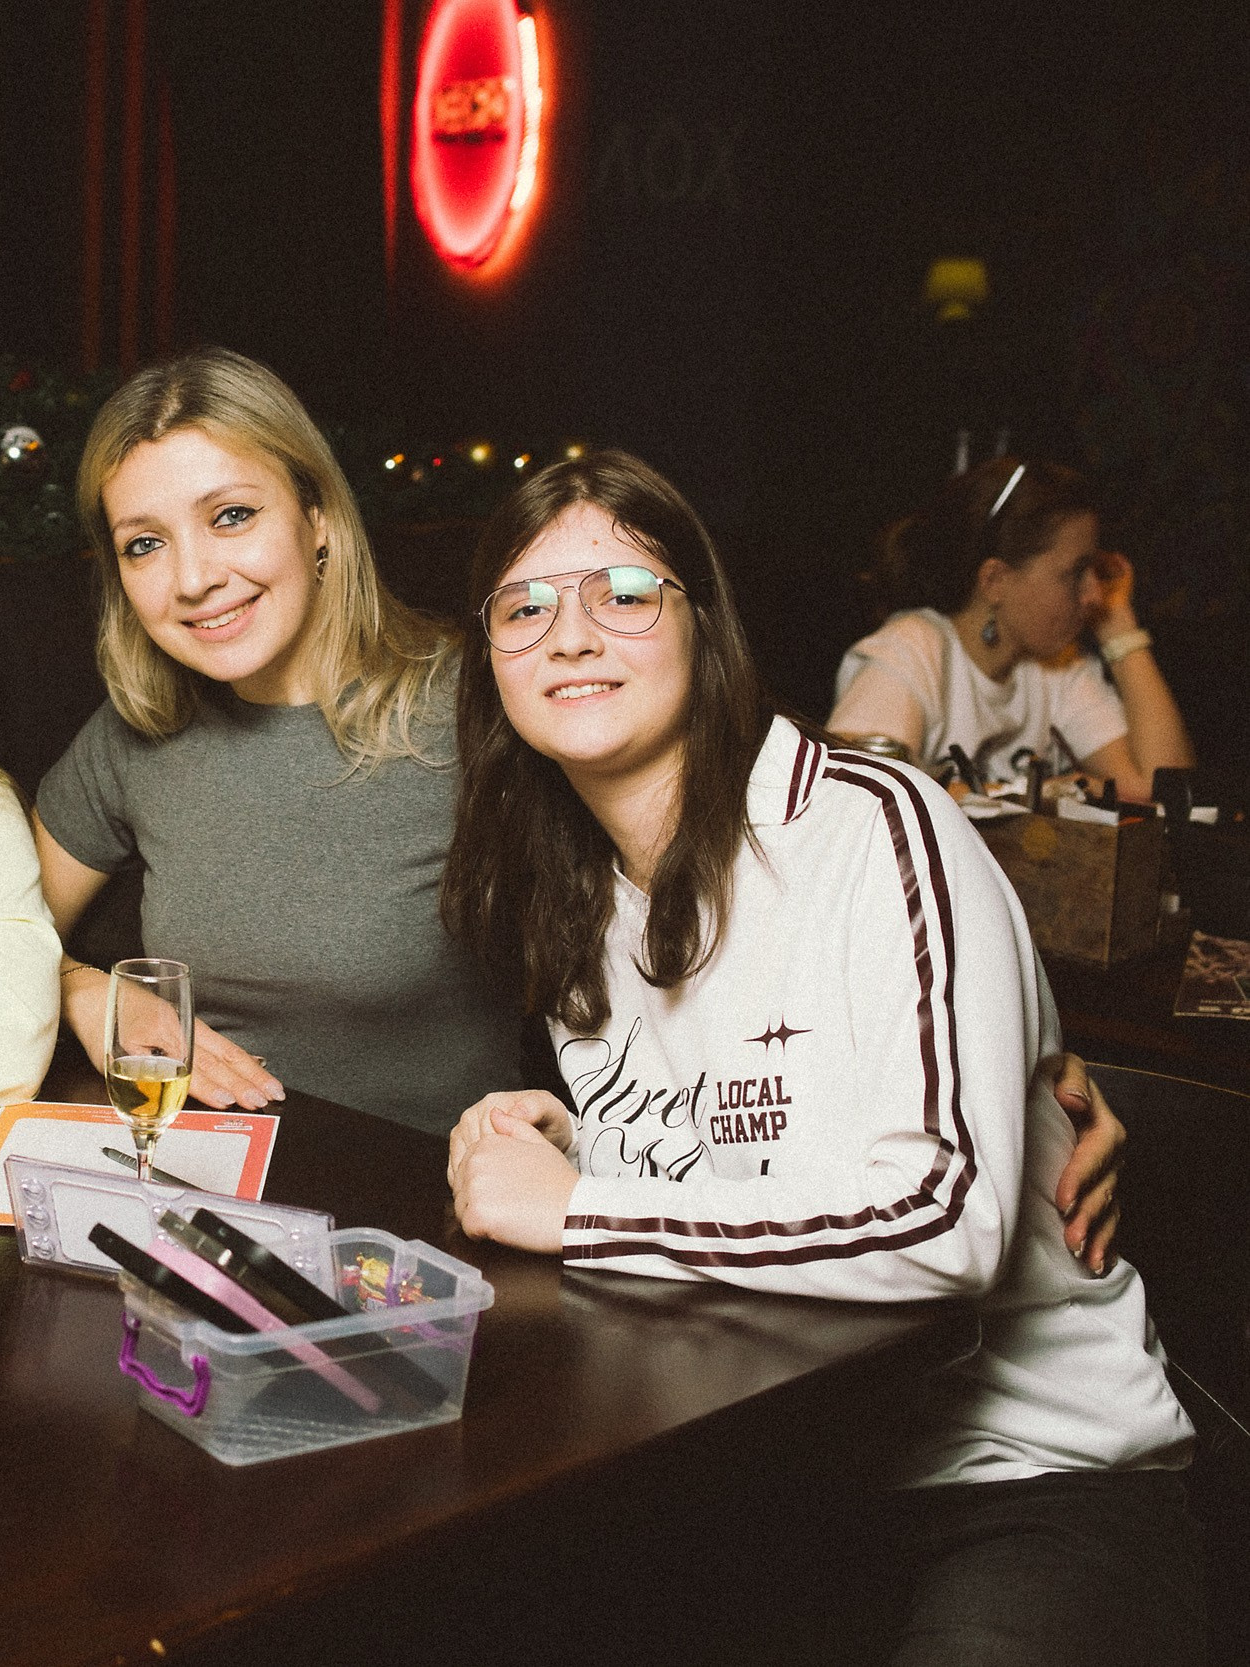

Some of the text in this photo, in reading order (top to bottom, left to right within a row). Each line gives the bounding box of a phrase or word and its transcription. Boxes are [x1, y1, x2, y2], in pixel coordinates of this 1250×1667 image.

[559, 1017, 707, 1130] Street
[717, 1075, 792, 1111] LOCAL
[710, 1110, 787, 1145] CHAMP
